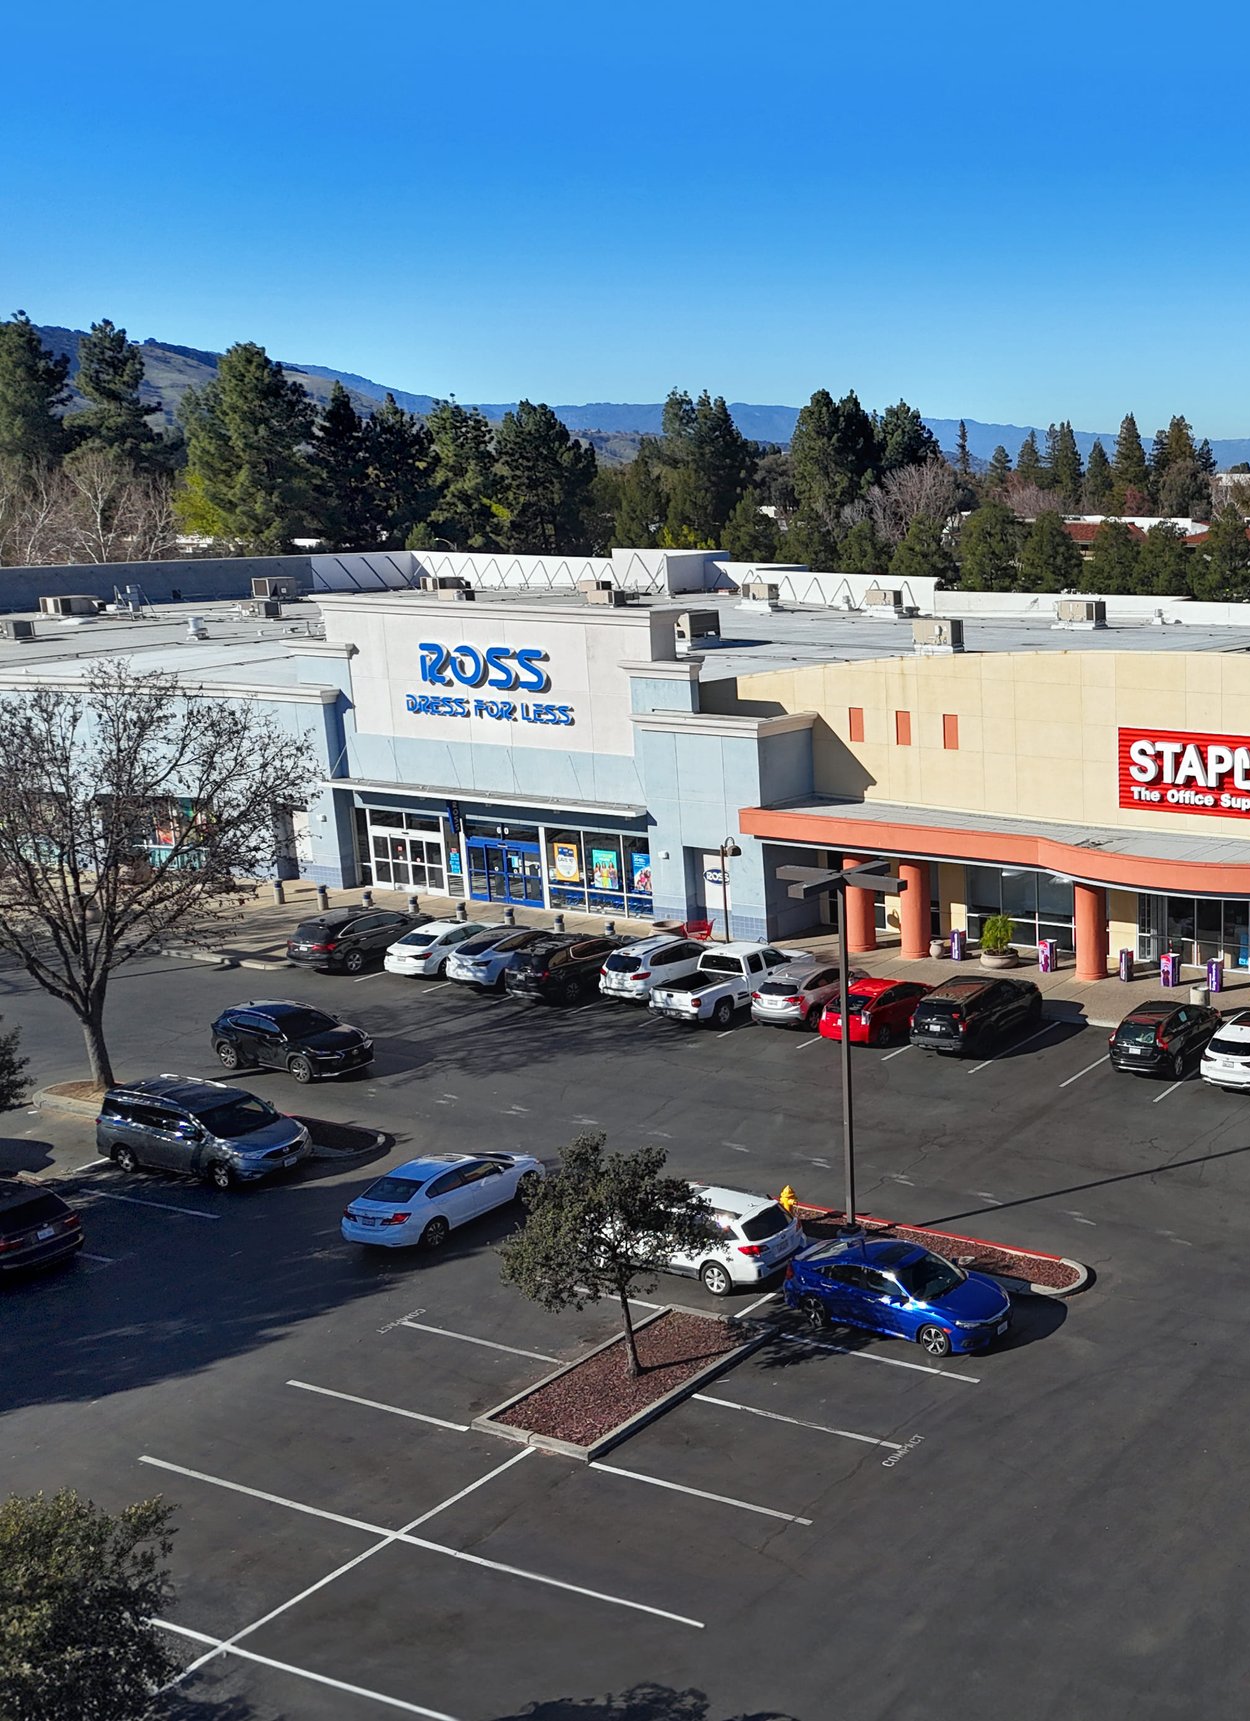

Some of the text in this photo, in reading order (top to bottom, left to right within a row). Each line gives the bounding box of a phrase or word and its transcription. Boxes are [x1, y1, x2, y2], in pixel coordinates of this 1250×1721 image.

[418, 642, 550, 692] ROSS
[406, 694, 573, 725] DRESS FOR LESS
[1130, 786, 1161, 802] The
[1167, 789, 1214, 806] Office
[881, 1433, 926, 1468] COMPACT
